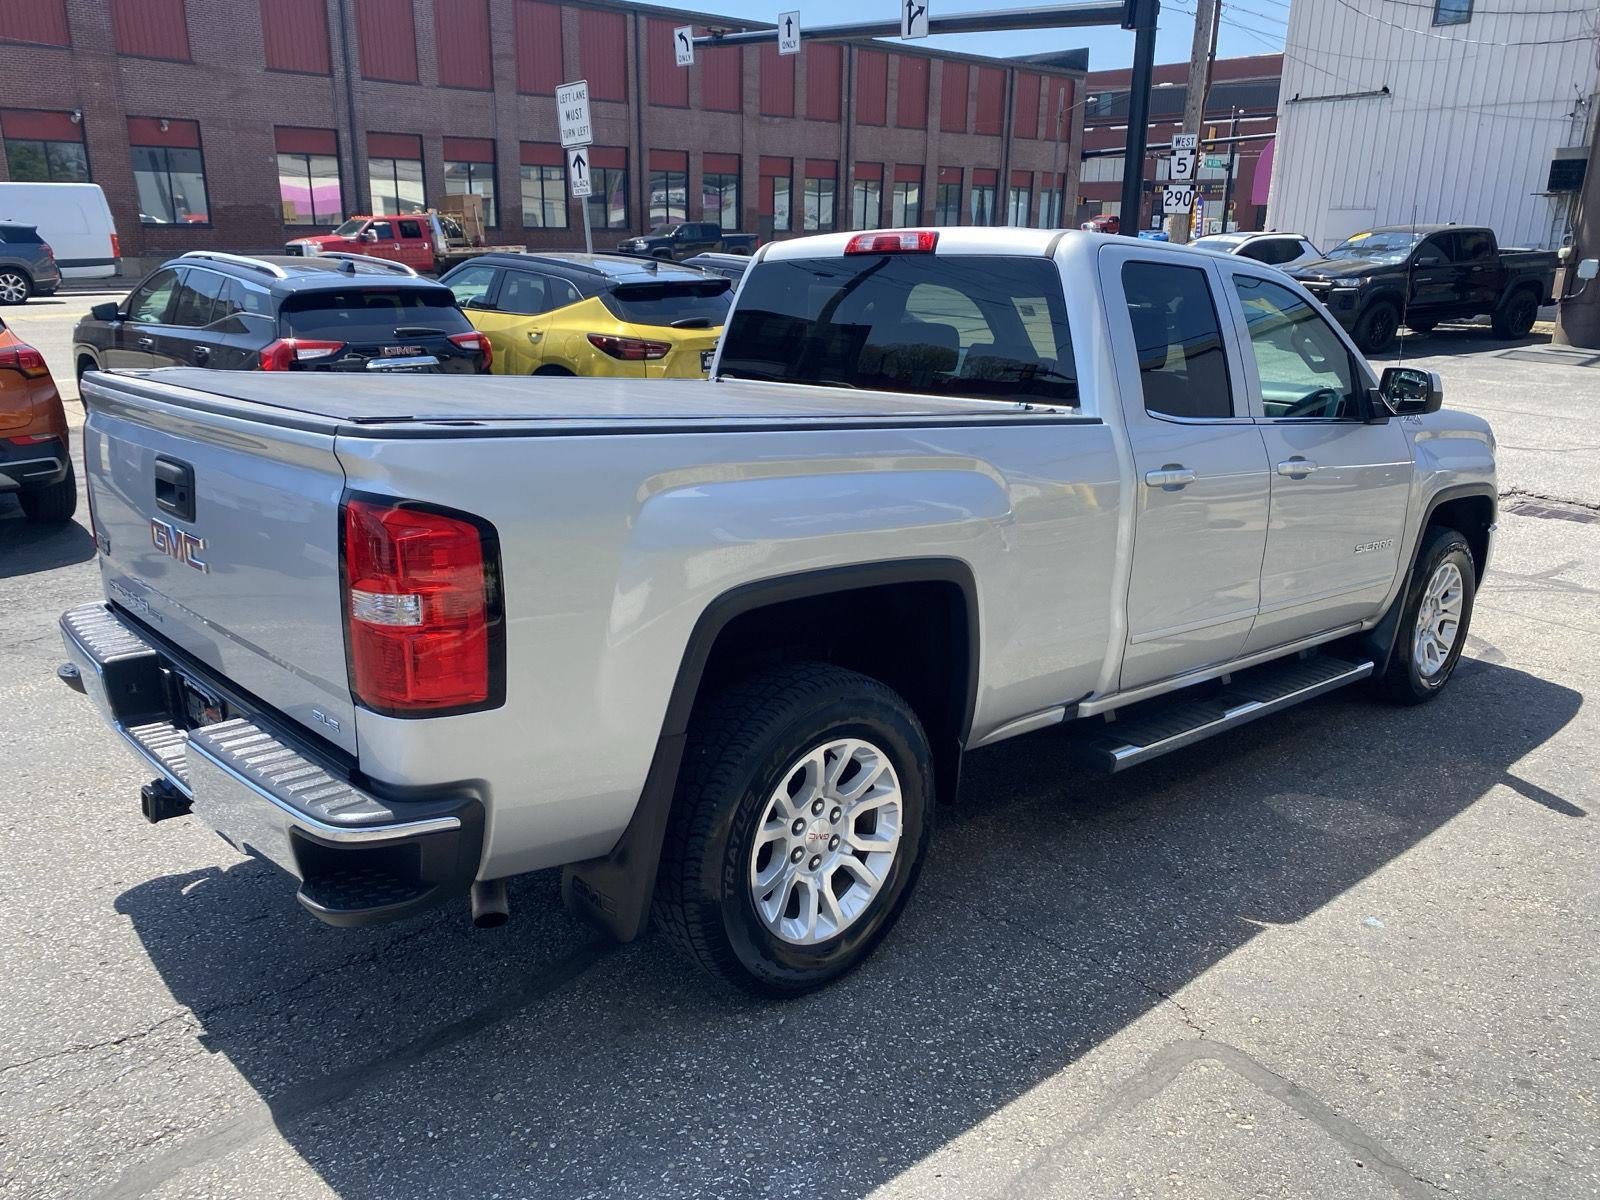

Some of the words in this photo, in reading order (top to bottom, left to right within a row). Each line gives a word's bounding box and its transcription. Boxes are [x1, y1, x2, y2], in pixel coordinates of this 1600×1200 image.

[782, 40, 797, 49] ONLY
[678, 54, 692, 63] ONLY
[560, 93, 571, 104] LEFT
[573, 90, 586, 101] LANE
[565, 108, 583, 120] MUST
[562, 129, 576, 138] TURN
[577, 126, 589, 137] LEFT
[1175, 137, 1195, 147] WEST
[1176, 157, 1187, 173] 5
[1164, 191, 1192, 207] 290
[384, 346, 422, 356] GMC
[151, 517, 209, 574] GMC
[1354, 539, 1393, 554] SIERRA
